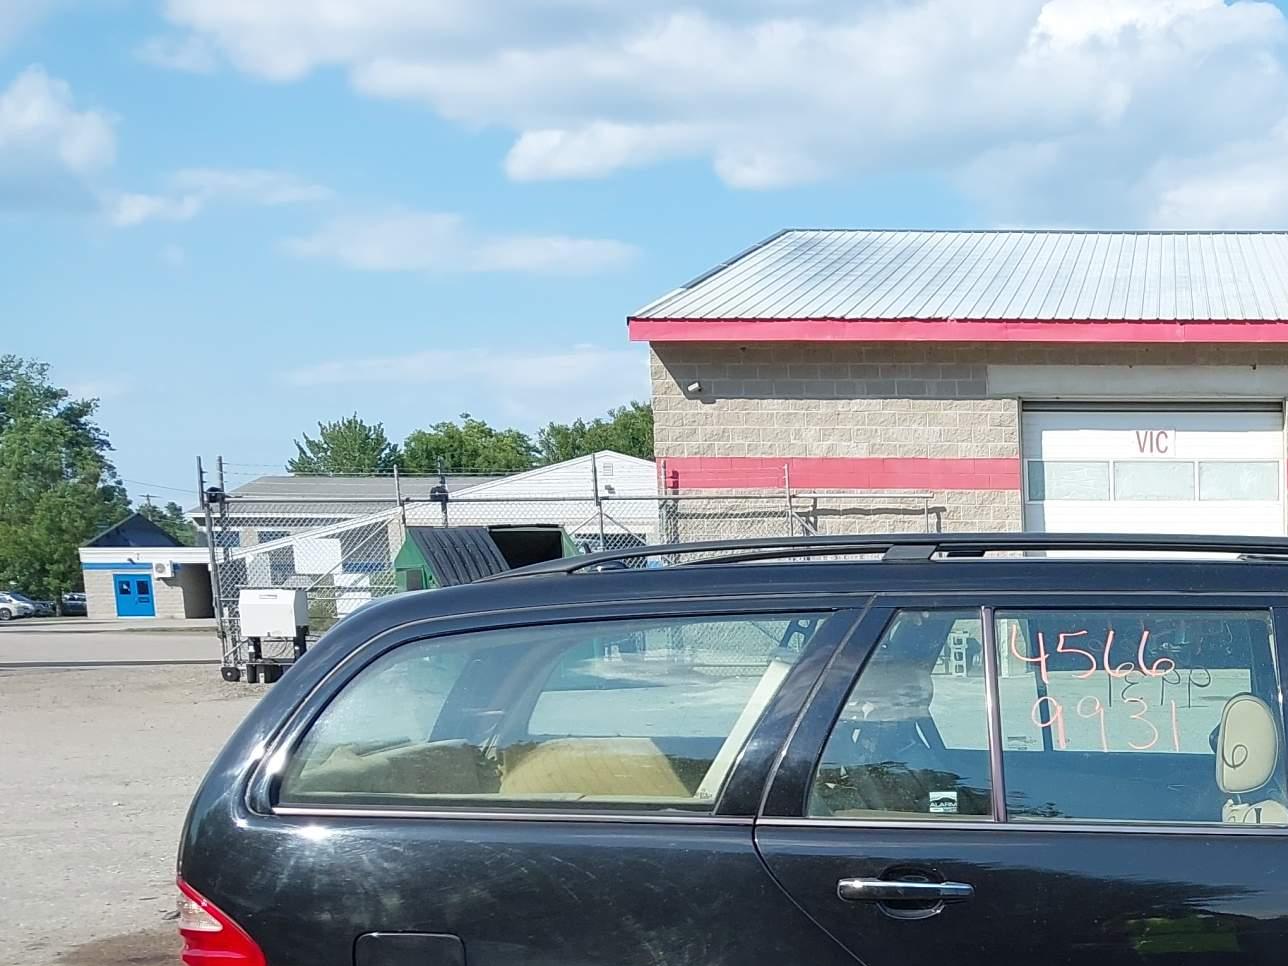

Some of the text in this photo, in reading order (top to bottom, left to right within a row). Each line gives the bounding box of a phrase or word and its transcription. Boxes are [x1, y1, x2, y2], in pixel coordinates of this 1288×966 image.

[1135, 430, 1169, 454] VIC
[1011, 624, 1176, 684] 4566
[1031, 696, 1180, 752] 9931
